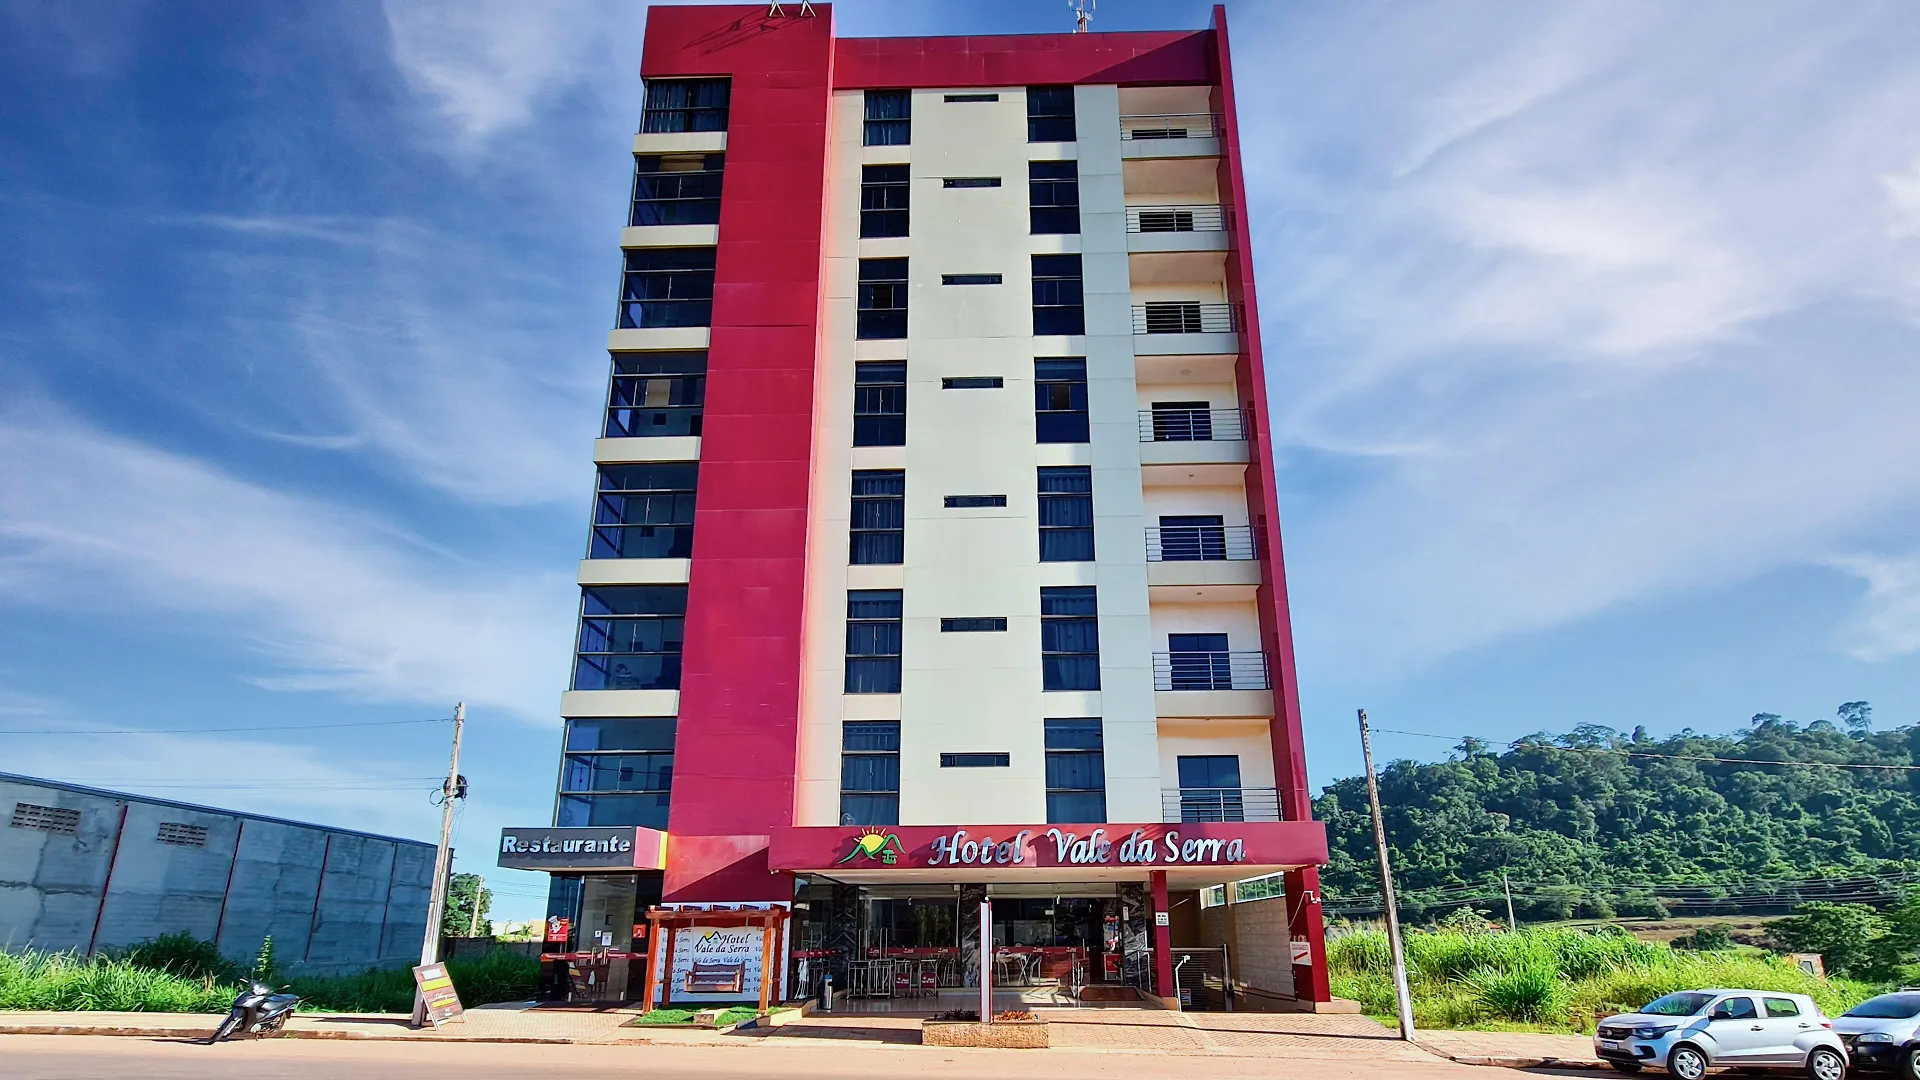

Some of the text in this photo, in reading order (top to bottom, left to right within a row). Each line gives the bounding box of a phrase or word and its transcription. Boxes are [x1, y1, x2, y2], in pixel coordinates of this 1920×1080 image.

[501, 835, 631, 854] Restaurante
[927, 828, 1247, 866] Hotel Vale da Serra
[720, 933, 752, 944] Hotel
[694, 944, 750, 954] Vale da Serra
